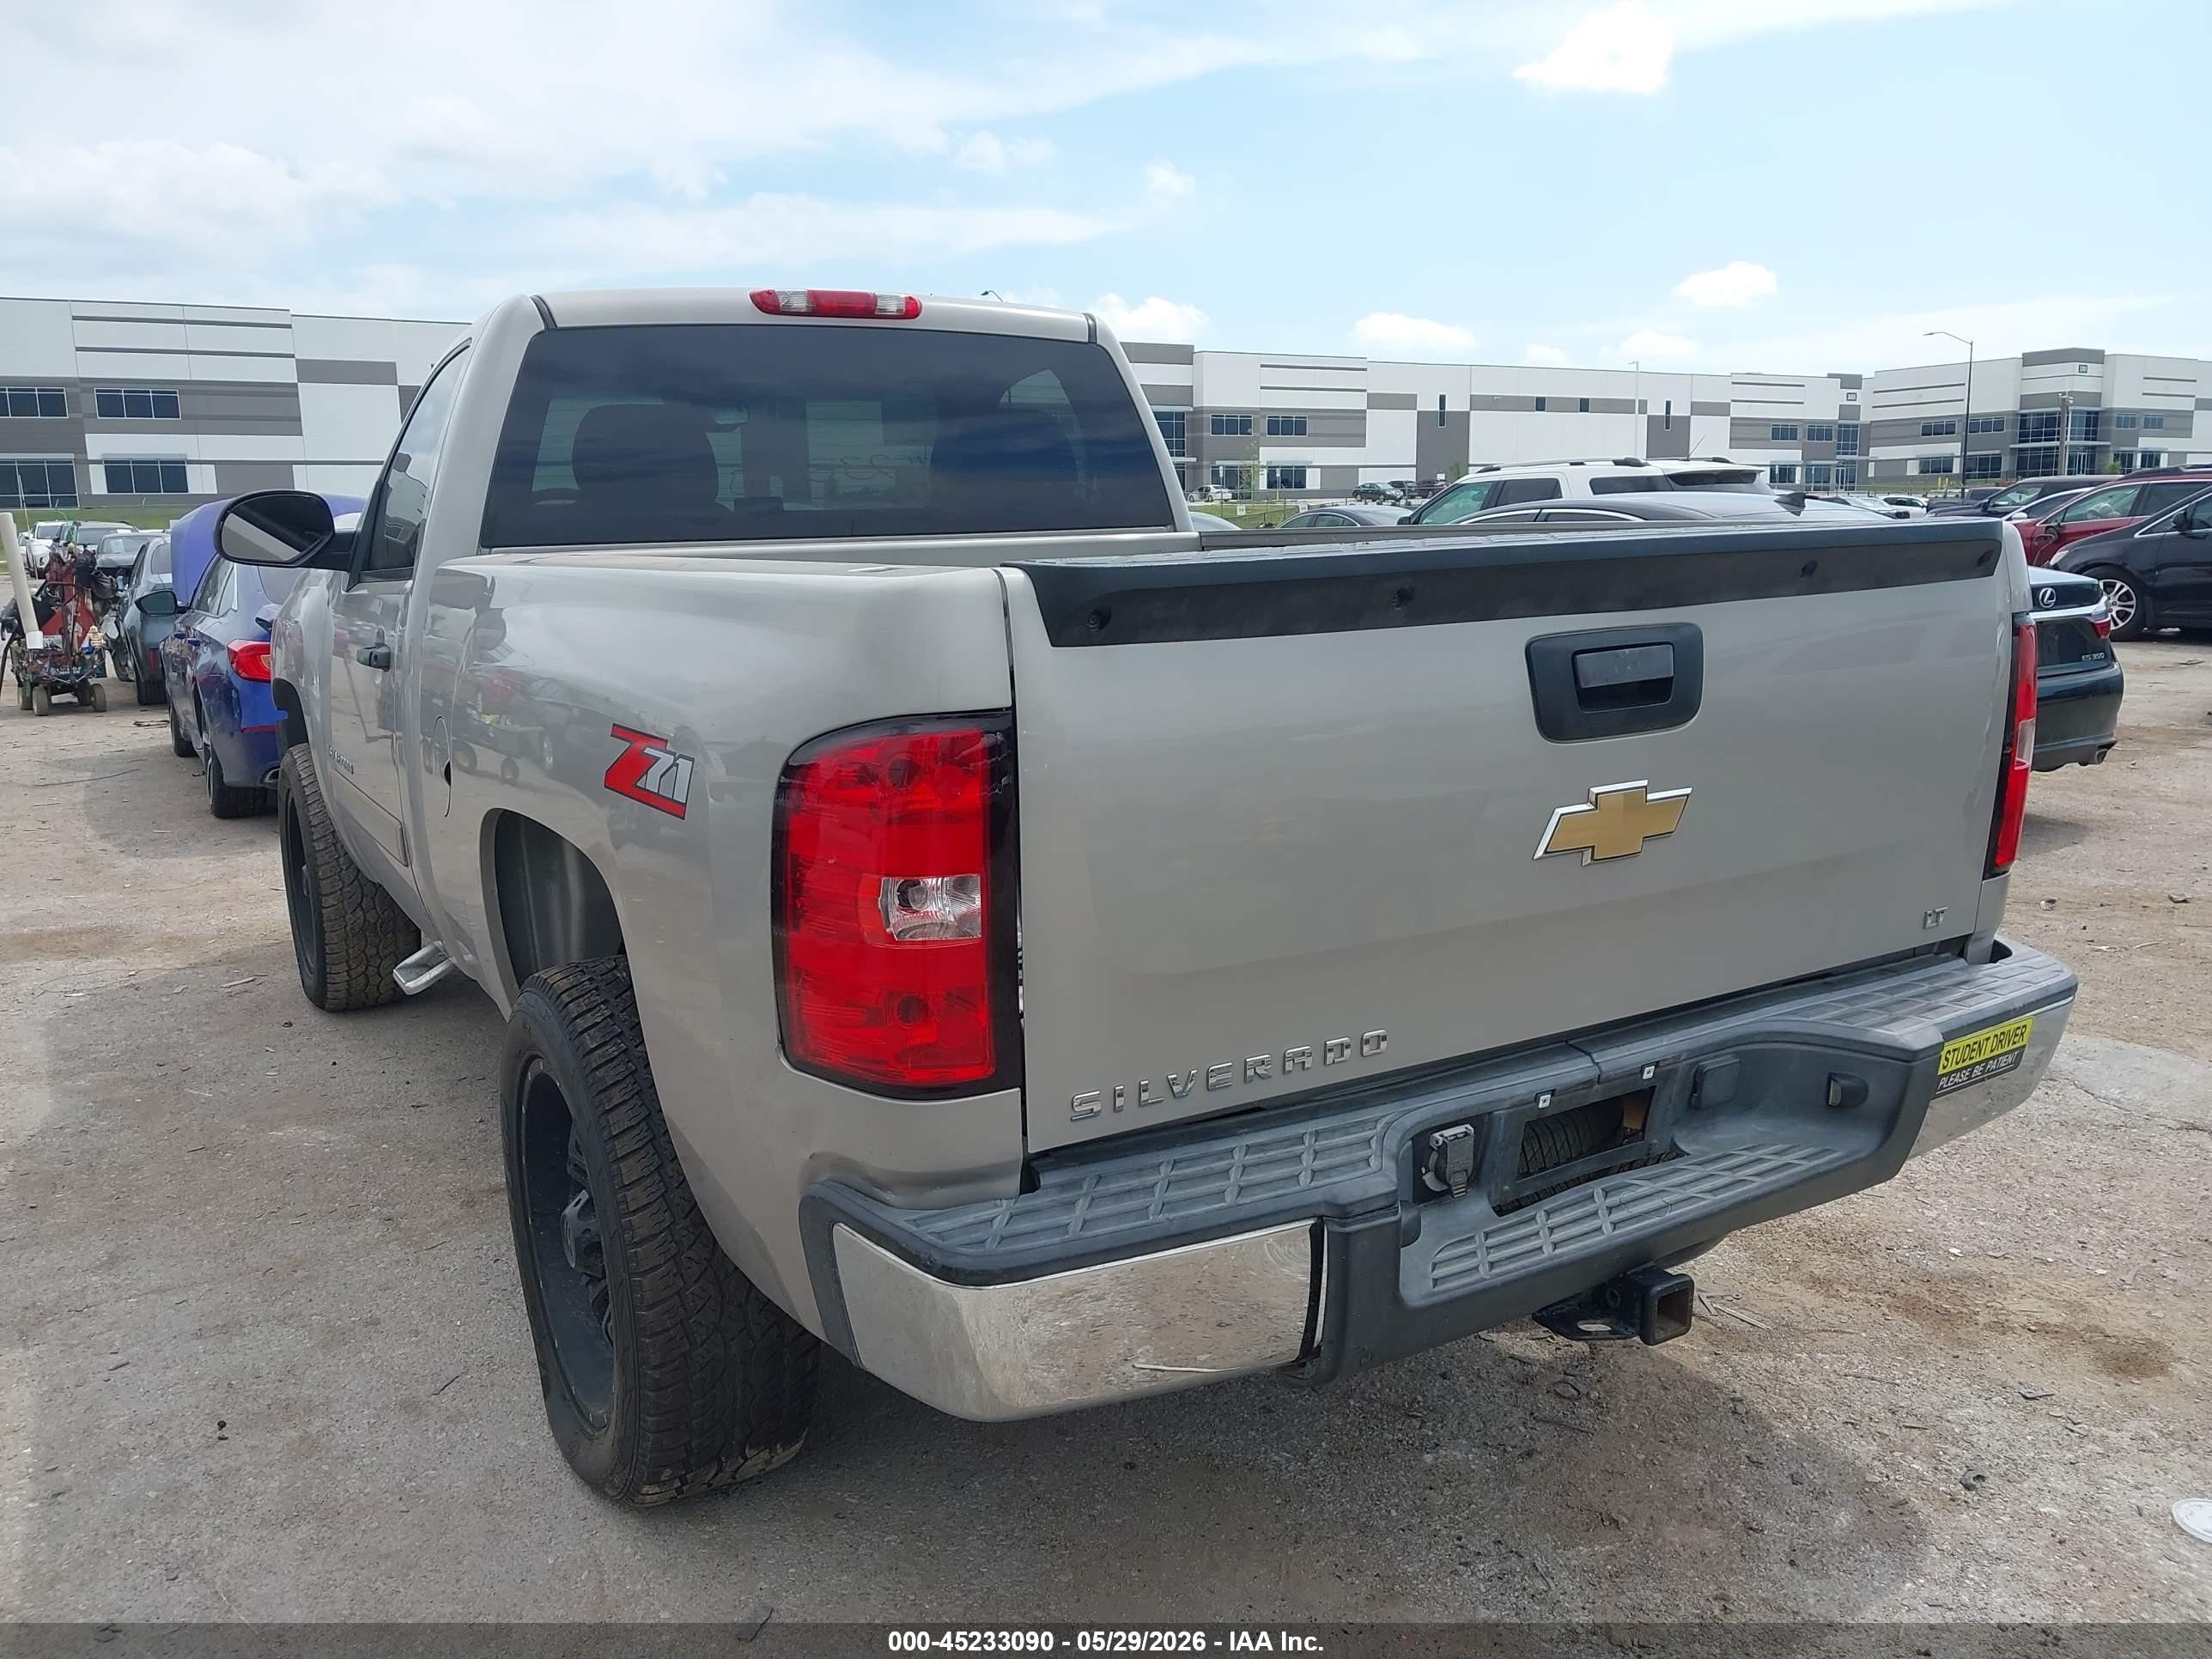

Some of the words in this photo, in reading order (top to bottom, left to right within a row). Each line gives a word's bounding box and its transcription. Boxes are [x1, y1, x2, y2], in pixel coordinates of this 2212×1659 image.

[604, 722, 695, 820] Z71
[1923, 906, 1948, 929] LT
[1942, 1036, 1990, 1070] STUDENT
[1990, 1024, 2027, 1054] DRIVER
[1071, 1029, 1388, 1121] SILVERADO
[1937, 1068, 1971, 1091] PLEASE
[1972, 1064, 1984, 1078] BE
[1984, 1050, 2020, 1073] PATIENT
